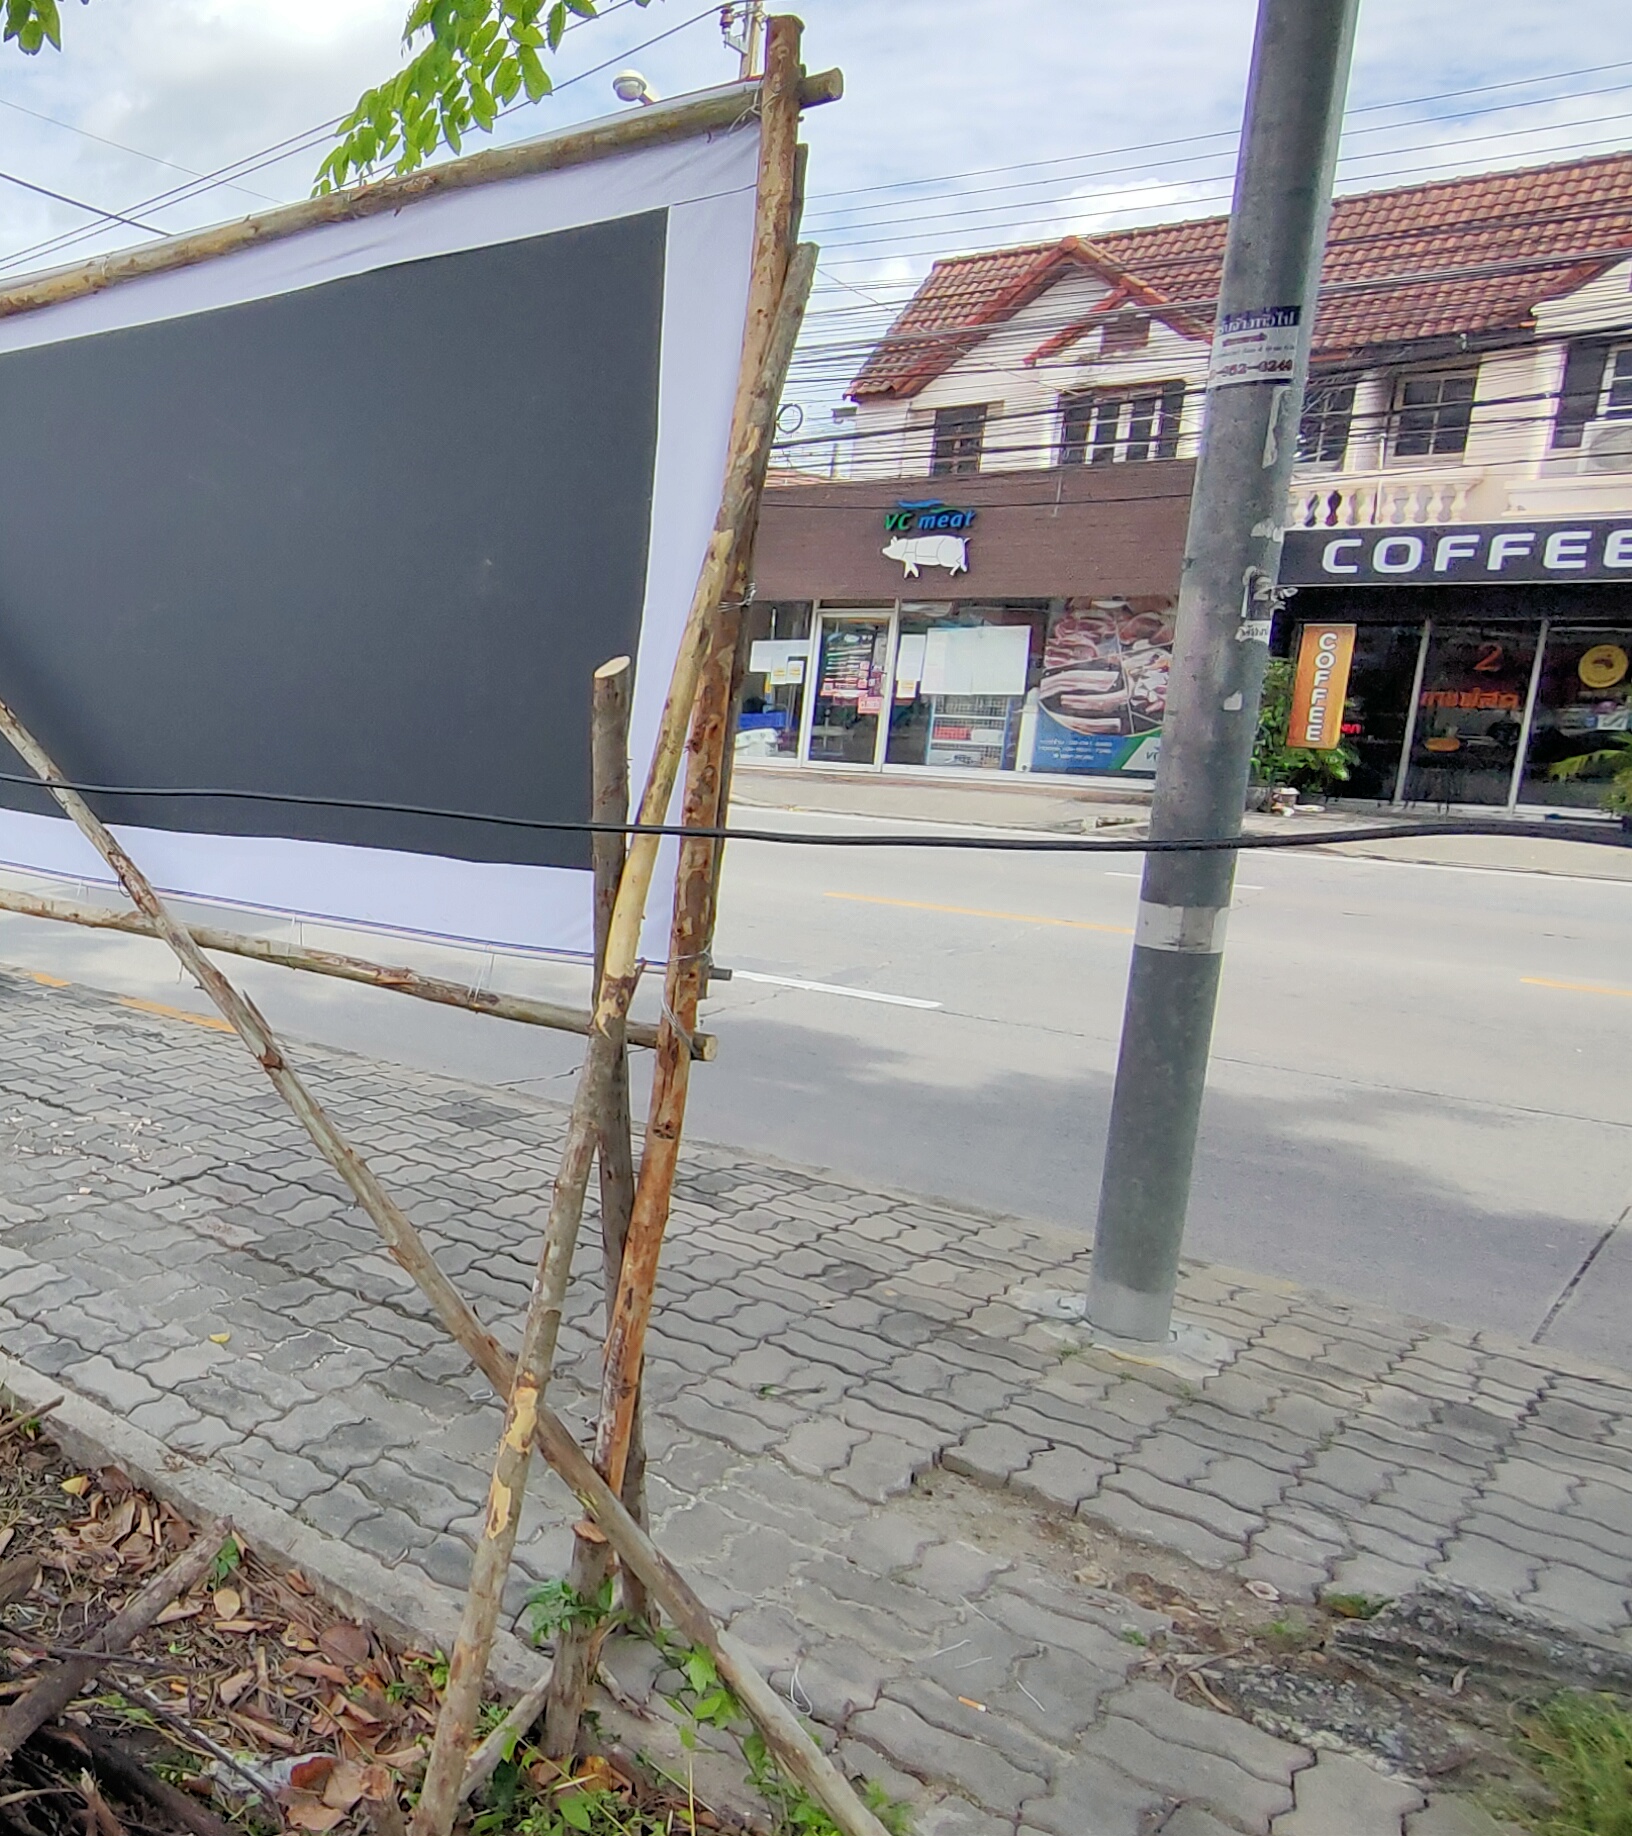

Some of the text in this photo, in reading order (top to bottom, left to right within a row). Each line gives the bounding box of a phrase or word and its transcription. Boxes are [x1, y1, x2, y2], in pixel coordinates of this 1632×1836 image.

[884, 509, 976, 531] VC meat
[1305, 632, 1338, 743] COFFEE
